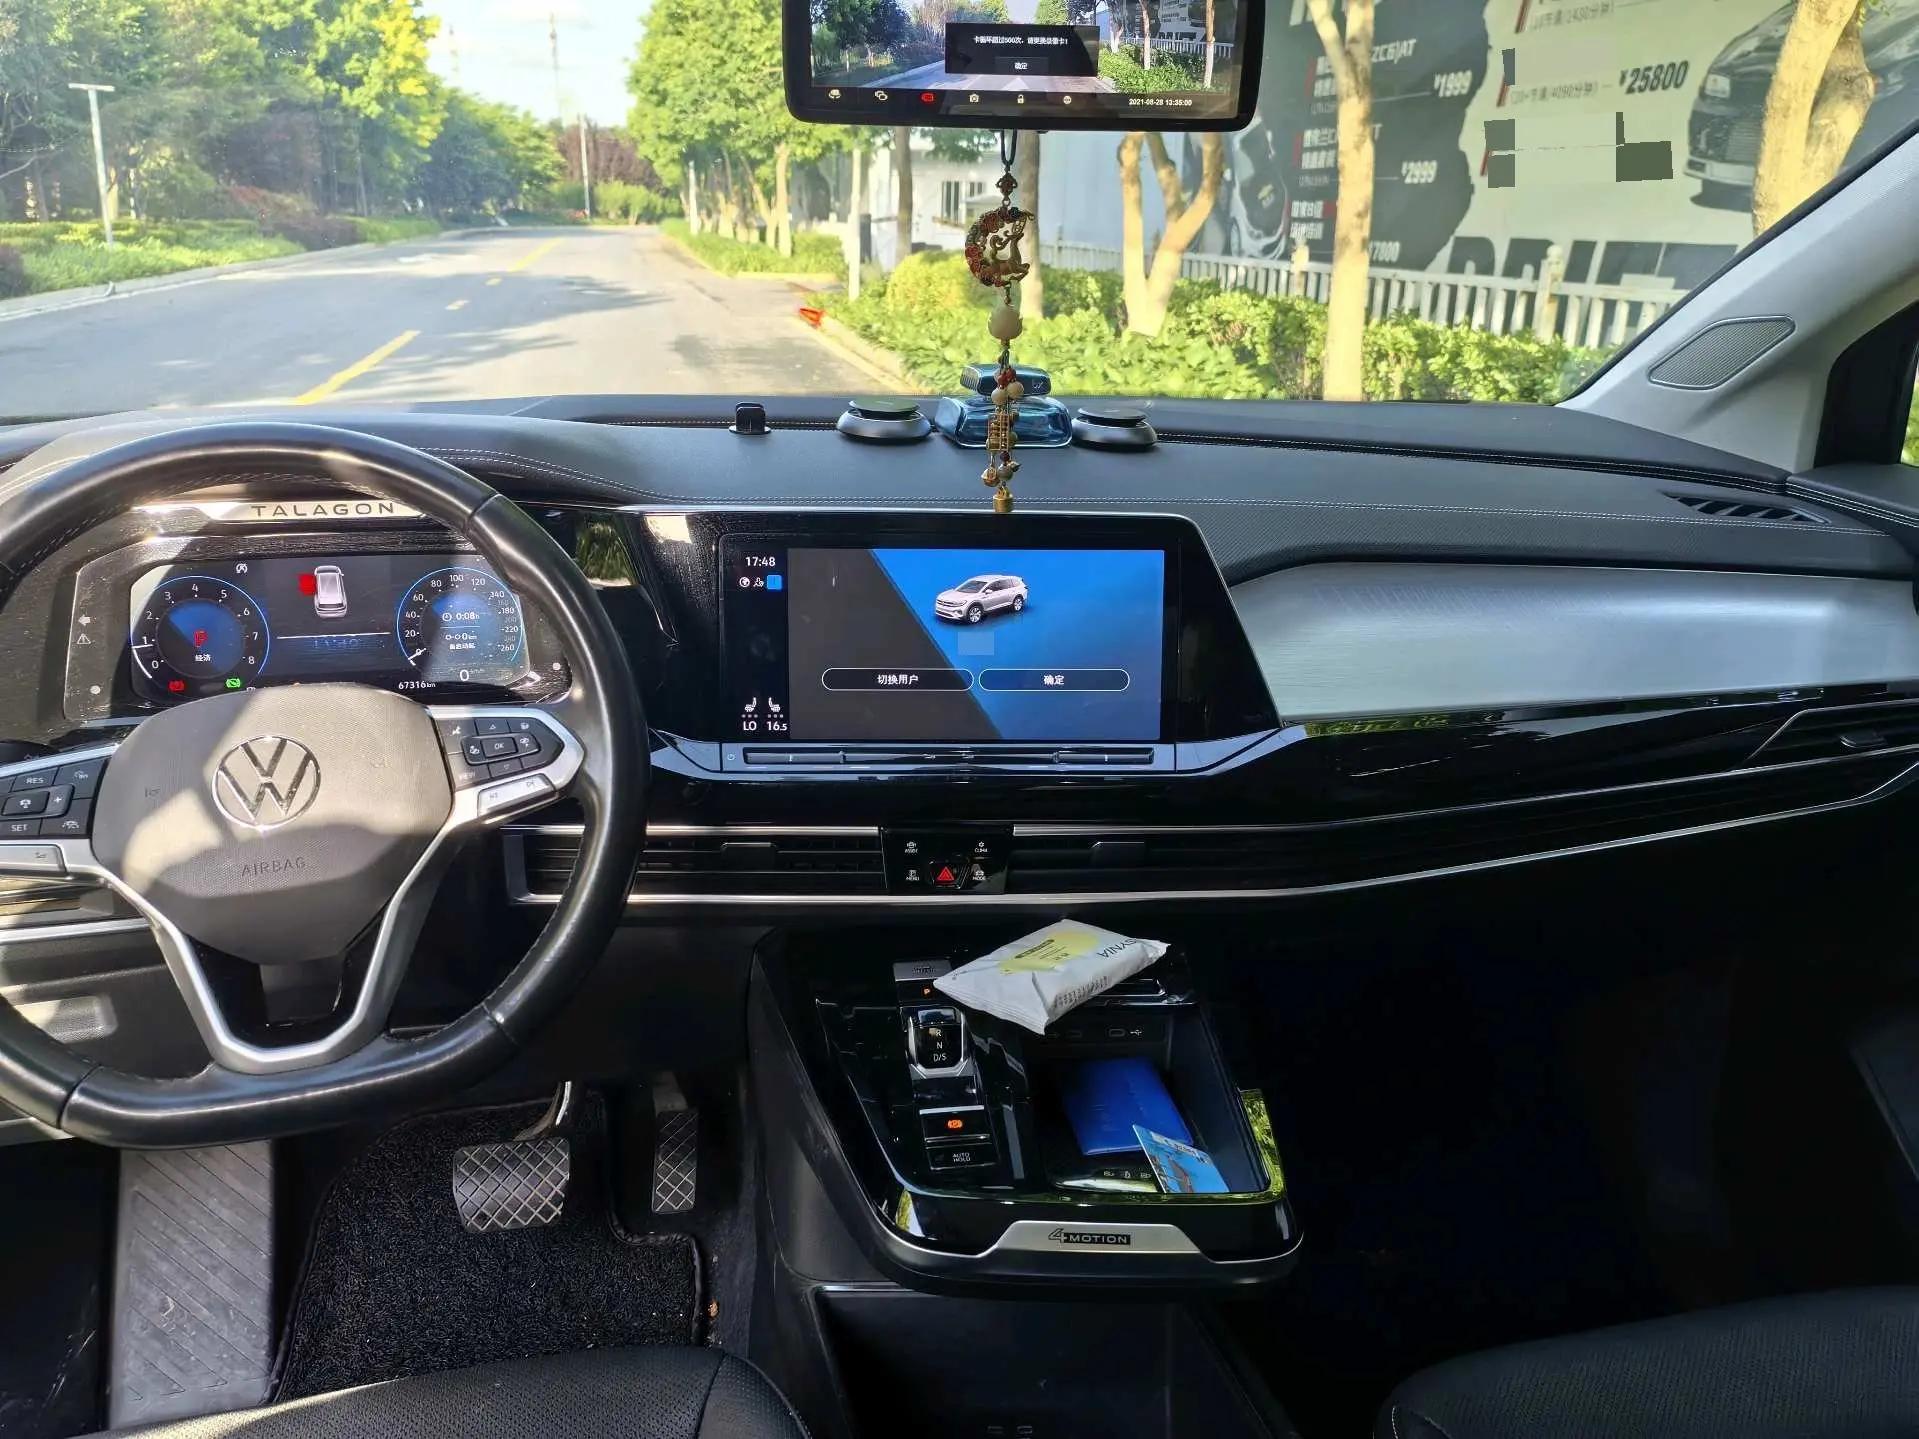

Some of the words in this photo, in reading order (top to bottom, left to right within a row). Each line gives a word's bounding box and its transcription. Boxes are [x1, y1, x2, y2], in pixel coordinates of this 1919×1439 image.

[1618, 60, 1690, 95] ¥25800
[1434, 70, 1472, 97] ¥1999
[1401, 160, 1437, 184] ¥2999
[252, 502, 394, 517] TALAGON
[745, 556, 776, 567] 17:48
[450, 574, 463, 582] 100
[472, 578, 485, 586] 120
[191, 583, 199, 592] 4
[431, 579, 441, 587] 80
[164, 591, 171, 600] 3
[221, 589, 227, 598] 5
[413, 593, 424, 601] 60
[146, 611, 153, 620] 2
[243, 607, 250, 616] 6
[195, 653, 211, 662] 经济
[248, 655, 255, 665] 8
[151, 660, 159, 669] 0
[460, 669, 470, 682] 0
[877, 674, 919, 685] 切换用户
[1044, 674, 1064, 685] 确定
[743, 720, 757, 731] LO
[11, 823, 29, 832] SET
[242, 857, 306, 877] AIRBAG
[936, 1029, 942, 1037] R
[933, 1053, 947, 1062] D/S
[1048, 1228, 1130, 1246] 4MOTION
